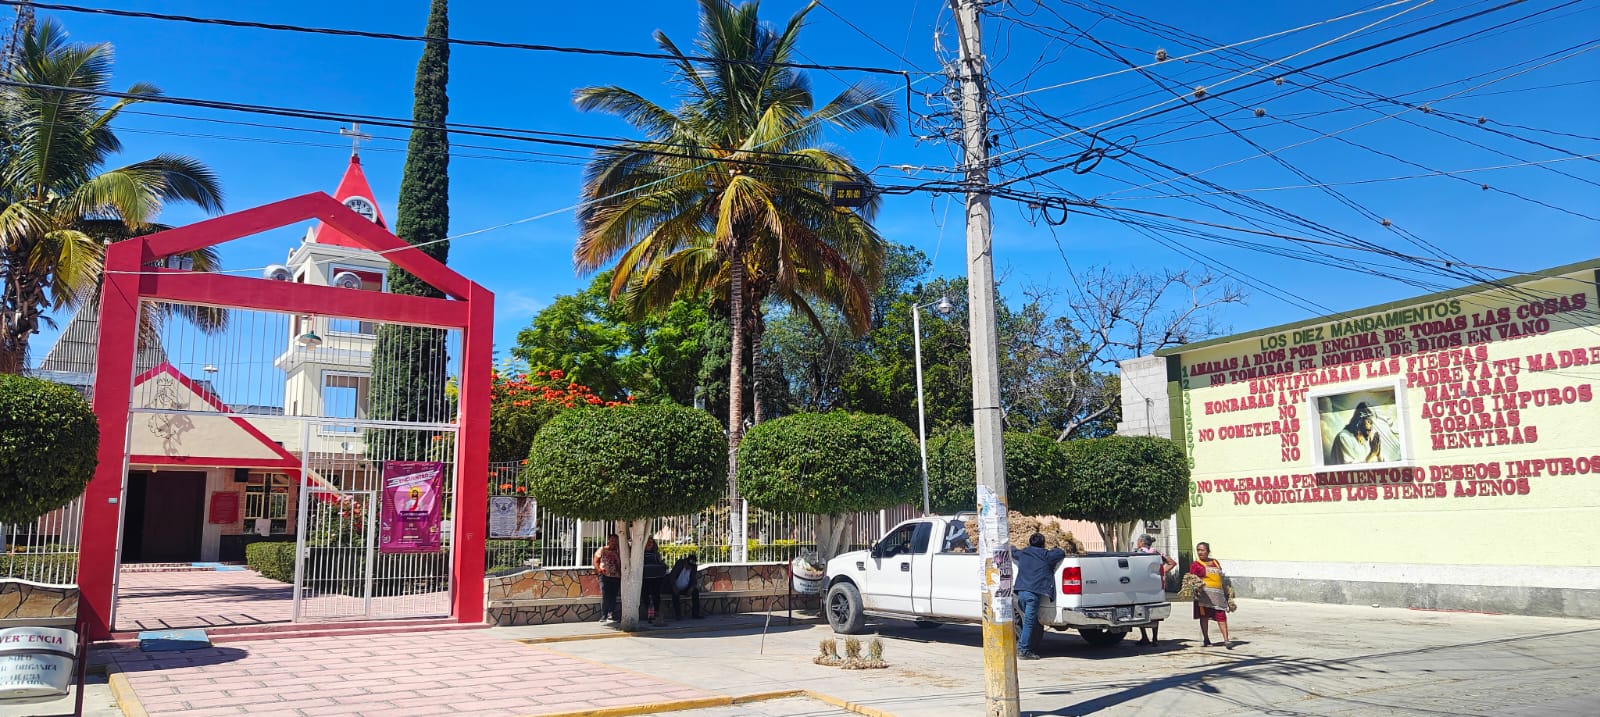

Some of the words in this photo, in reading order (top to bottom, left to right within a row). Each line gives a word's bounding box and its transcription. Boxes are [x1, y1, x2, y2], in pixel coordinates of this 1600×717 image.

[1182, 366, 1188, 378] 1
[1190, 356, 1239, 377] AMARAS
[1242, 354, 1250, 367] A
[1253, 347, 1286, 366] DIOS
[1290, 344, 1318, 360] POR
[1384, 327, 1405, 345] DE
[1409, 315, 1467, 339] TODAS
[1472, 307, 1511, 328] LAS
[1517, 293, 1587, 320] COSAS
[1260, 334, 1287, 351] LOS
[1293, 326, 1324, 345] DIEZ
[1331, 299, 1461, 337] MANDAMIENTOS
[1182, 379, 1190, 391] 2
[1210, 372, 1226, 387] NO
[1229, 361, 1294, 384] TOMARAS
[1299, 358, 1316, 375] EL
[1321, 344, 1384, 370] NOMBRE
[1390, 341, 1412, 357] DE
[1417, 333, 1463, 354] DIOS
[1467, 327, 1493, 346] EN
[1496, 318, 1550, 340] VANO
[1366, 359, 1400, 379] LAS
[1406, 345, 1488, 372] FIESTAS
[1406, 365, 1463, 388] PADRE
[1493, 357, 1520, 377] TU
[1526, 346, 1600, 372] MADRE
[1421, 398, 1485, 419] ACTOS
[1491, 383, 1593, 412] IMPUROS
[1424, 375, 1519, 402] MATARAS
[1204, 391, 1275, 416] HONRARAS
[1278, 390, 1287, 405] A
[1278, 404, 1296, 420] NO
[1199, 428, 1214, 442] NO
[1218, 418, 1300, 441] COMETERAS
[1429, 410, 1520, 434] ROBARAS
[1280, 432, 1299, 448] NO
[1431, 425, 1538, 451] MENTIRAS
[1281, 447, 1300, 462] NO
[1188, 481, 1197, 495] 9
[1197, 480, 1212, 494] NO
[1214, 474, 1289, 493] TOLERARAS
[1430, 462, 1501, 482] DESEOS
[1505, 455, 1600, 479] IMPUROS
[1190, 493, 1203, 508] 10
[1234, 492, 1250, 506] NO
[1346, 485, 1378, 502] LOS
[1383, 482, 1447, 501] BIENES
[1454, 478, 1531, 498] AJENOS
